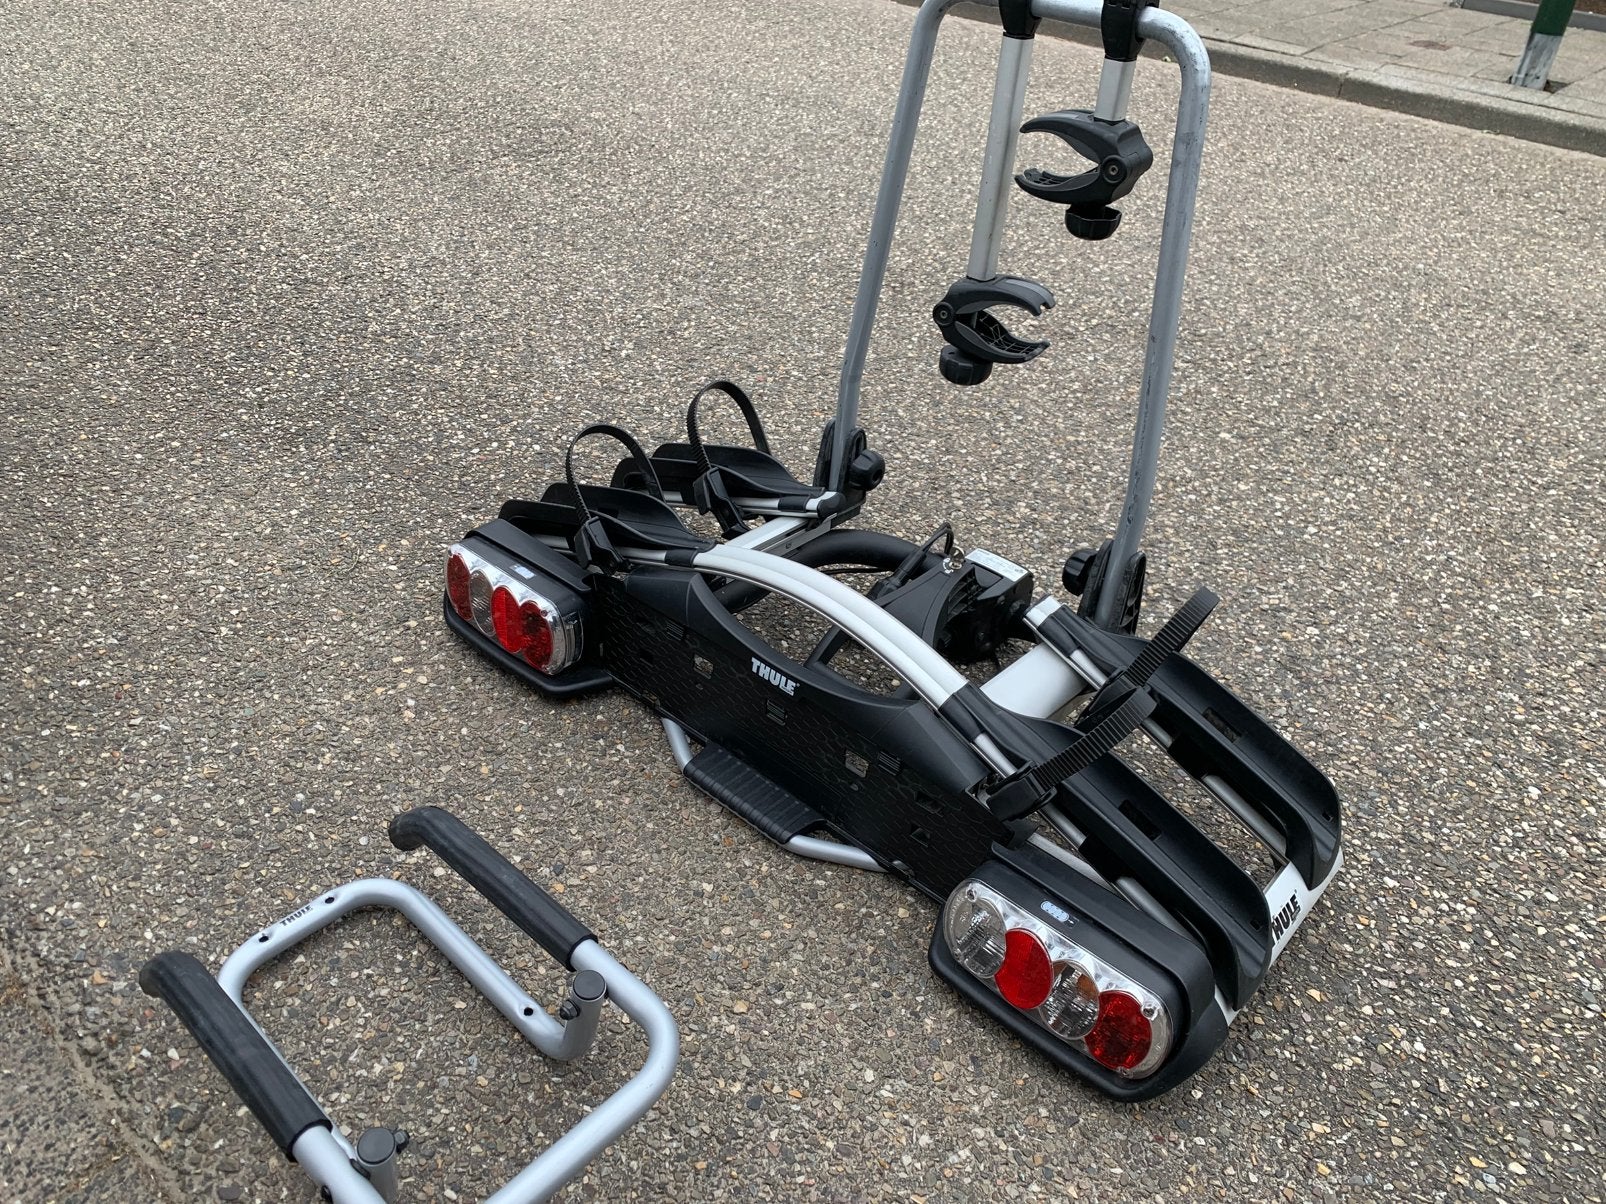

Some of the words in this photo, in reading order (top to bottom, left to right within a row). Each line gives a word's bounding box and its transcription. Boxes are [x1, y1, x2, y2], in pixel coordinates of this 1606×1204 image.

[751, 656, 797, 696] THULE
[280, 905, 313, 926] THULE
[1270, 893, 1301, 945] HULE
